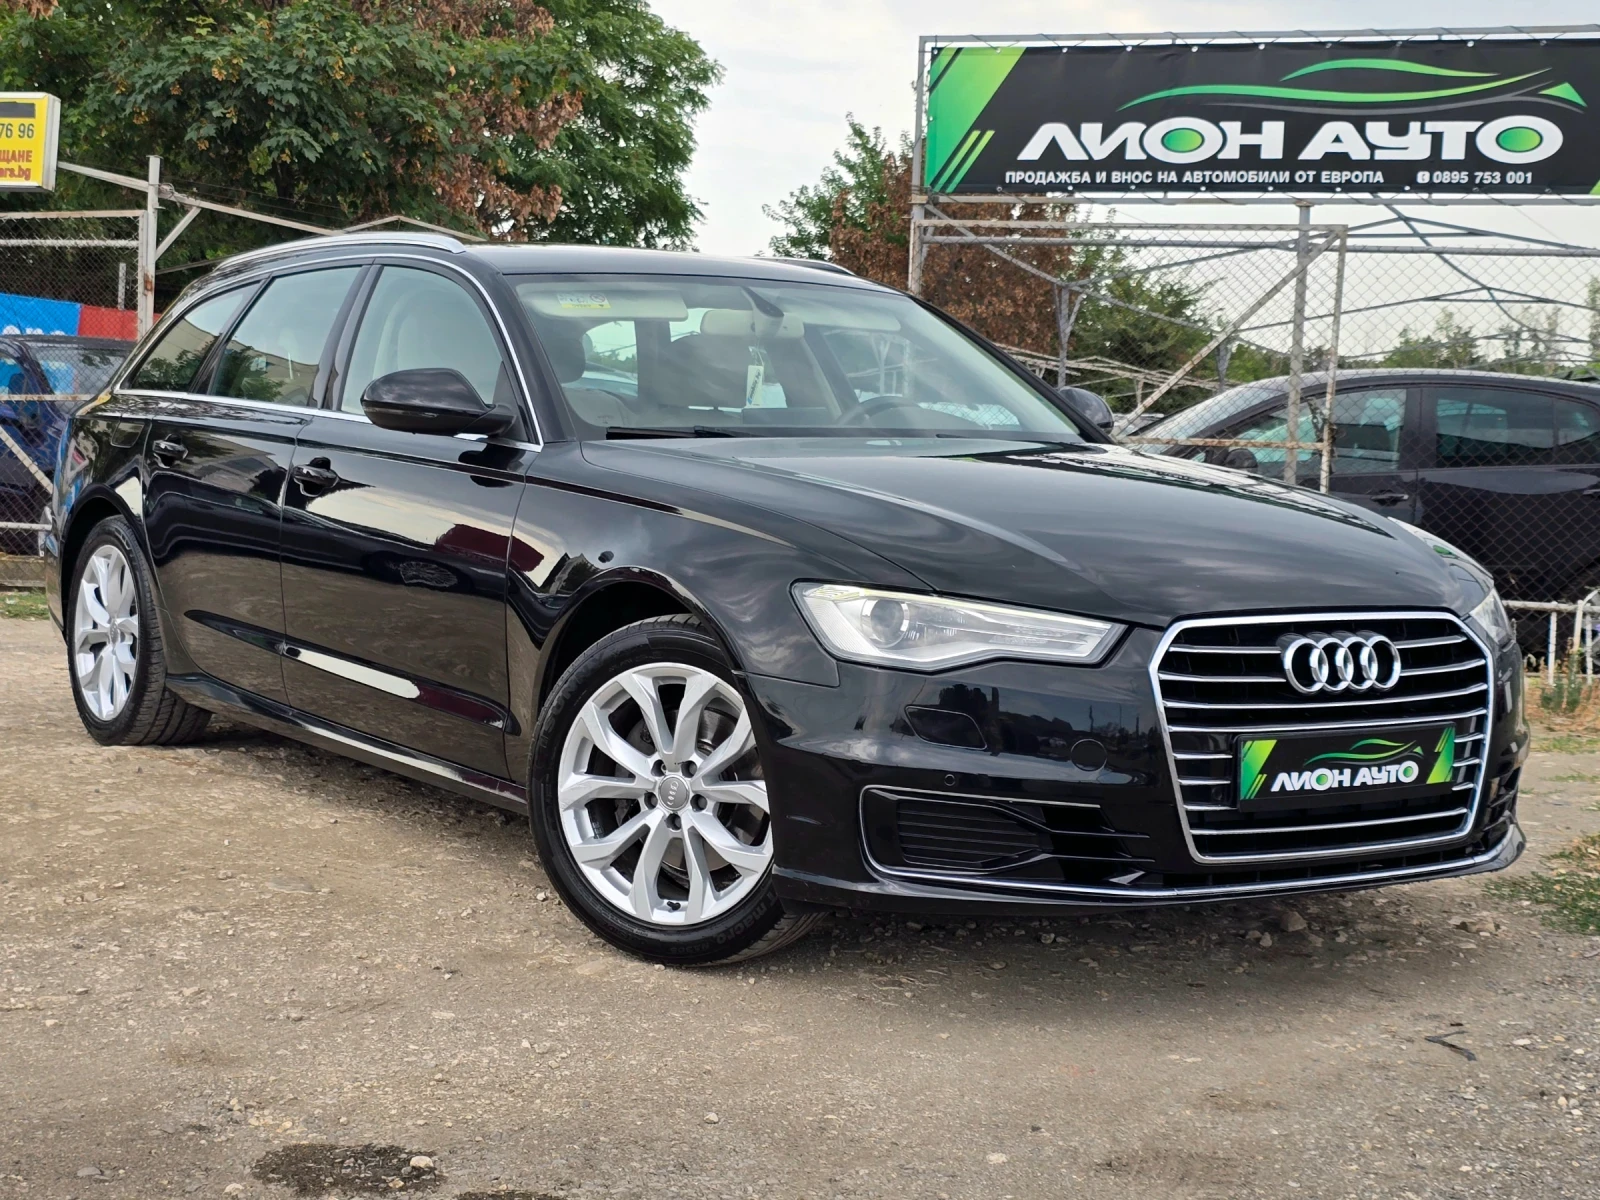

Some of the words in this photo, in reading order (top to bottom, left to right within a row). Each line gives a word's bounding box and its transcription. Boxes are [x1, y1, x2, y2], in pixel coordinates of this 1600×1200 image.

[18, 123, 34, 138] 96
[1017, 116, 1285, 164] ЛИОН
[1298, 115, 1564, 164] АУТО
[1005, 171, 1091, 185] ПРОДАЖБА
[1096, 171, 1106, 183] И
[1111, 171, 1153, 184] ВНОС
[1157, 171, 1178, 184] НА
[1182, 171, 1290, 184] АВТОМОБИЛИ
[1294, 171, 1316, 184] ОТ
[1320, 171, 1384, 184] ЕВРОПА
[1432, 171, 1468, 184] 0895
[1474, 171, 1501, 184] 753
[1506, 171, 1532, 184] 001
[1270, 768, 1350, 792] ЛИОН
[1353, 760, 1419, 786] АУТО
